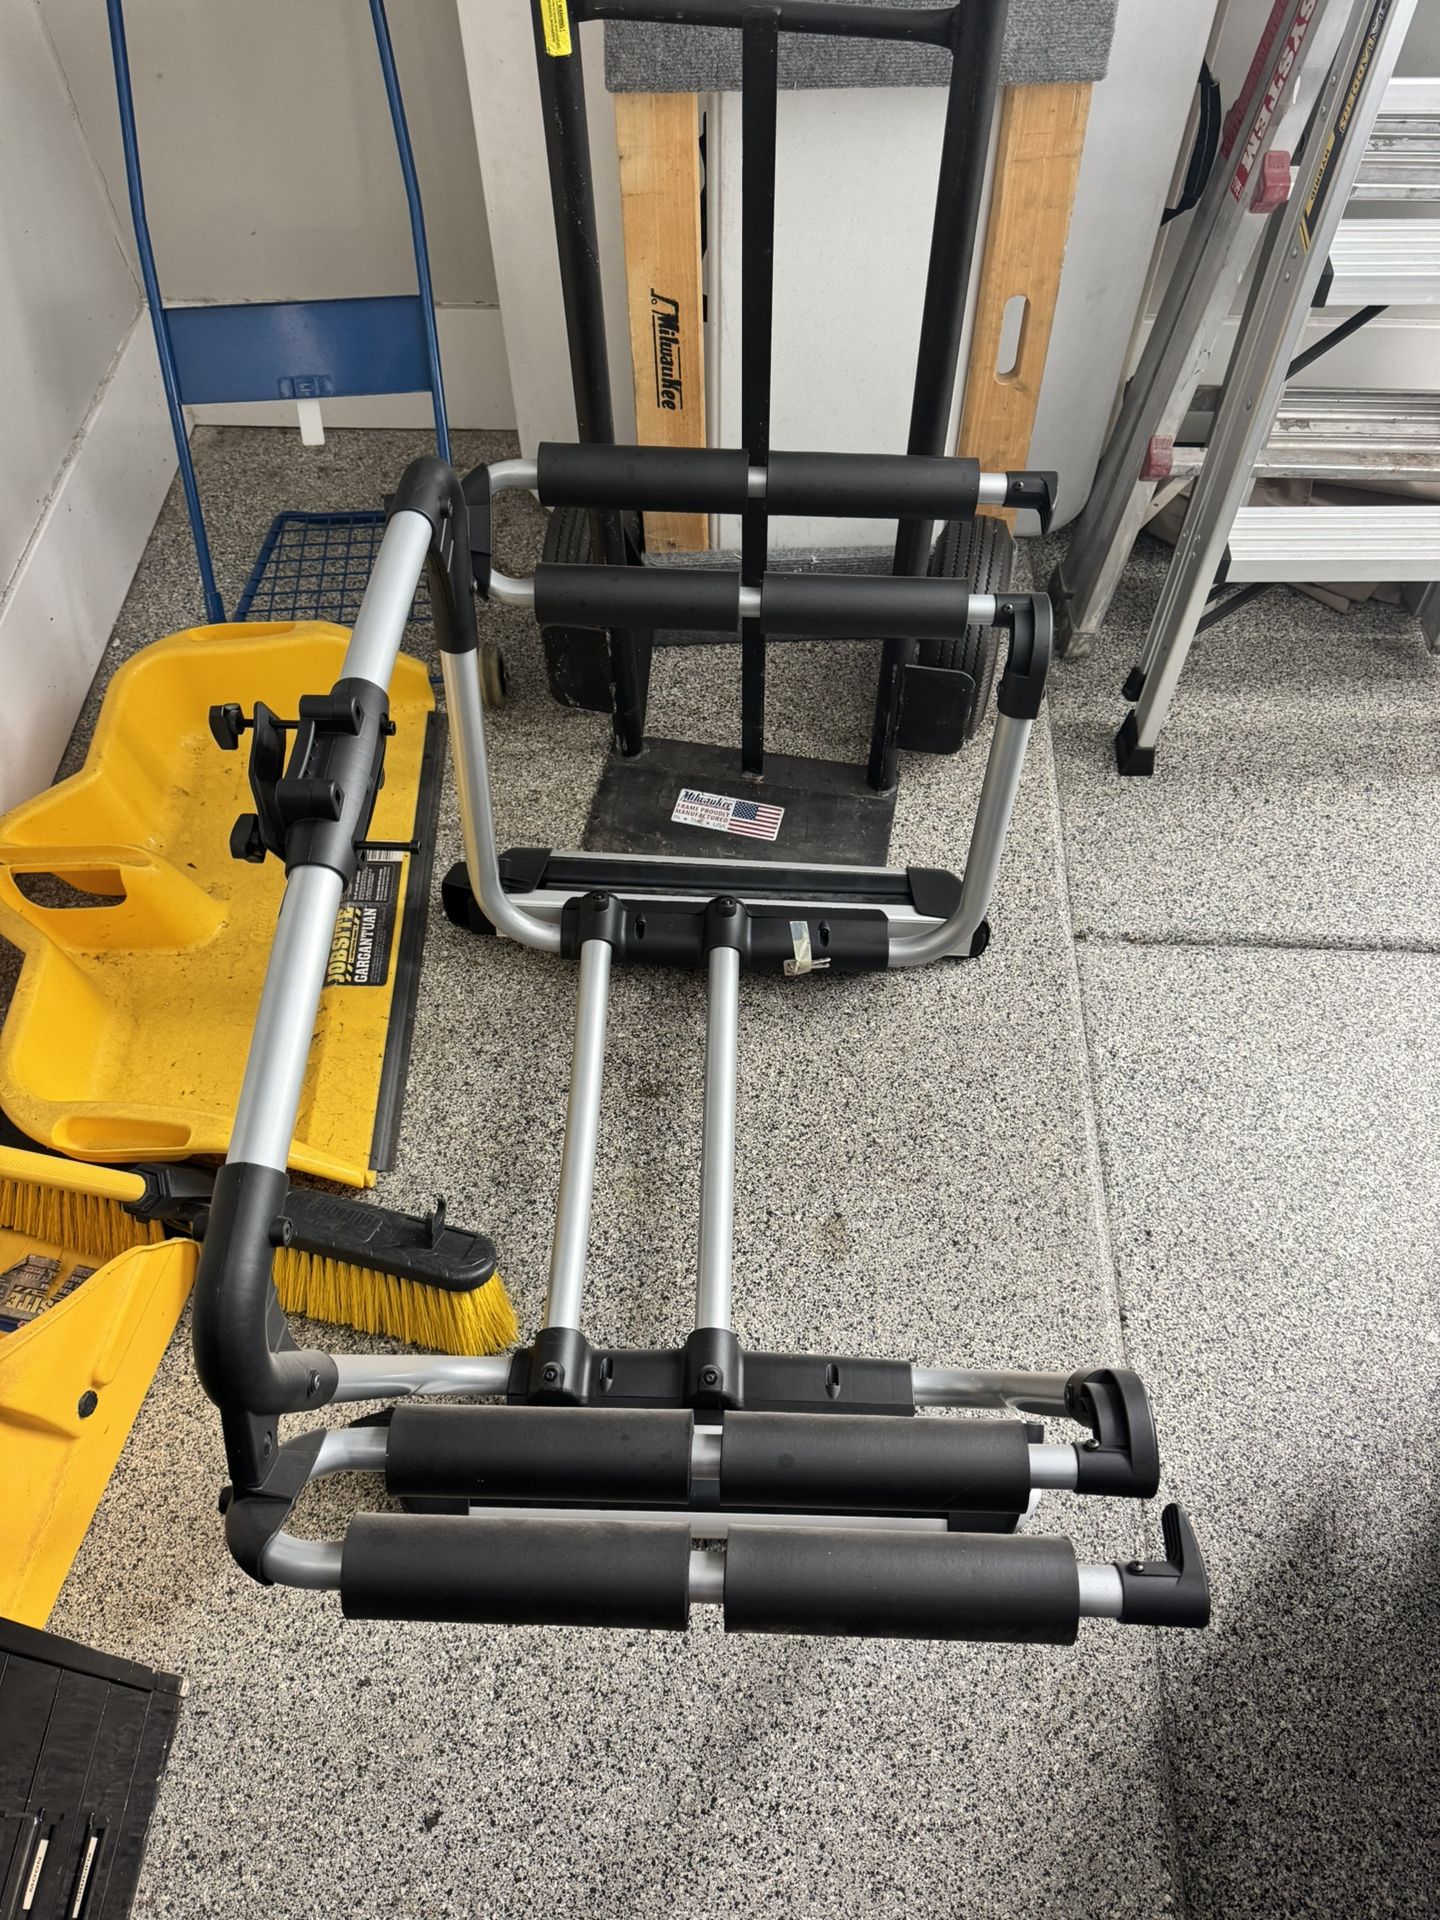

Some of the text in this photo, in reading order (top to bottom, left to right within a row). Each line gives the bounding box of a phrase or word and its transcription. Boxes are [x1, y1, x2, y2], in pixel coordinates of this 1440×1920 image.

[1242, 0, 1317, 172] SYSTEM
[1310, 149, 1330, 200] HYBRID
[651, 288, 682, 411] Milwaukee
[675, 808, 728, 823] MANUFACTURED
[677, 803, 730, 817] FRAME PROUDLY
[680, 790, 733, 809] Milwaukee
[713, 821, 726, 829] USA
[327, 906, 355, 982] JOBSITE
[354, 908, 377, 983] GARGANTUAN
[6, 1291, 54, 1314] SITE
[29, 1856, 42, 1893] MOON
